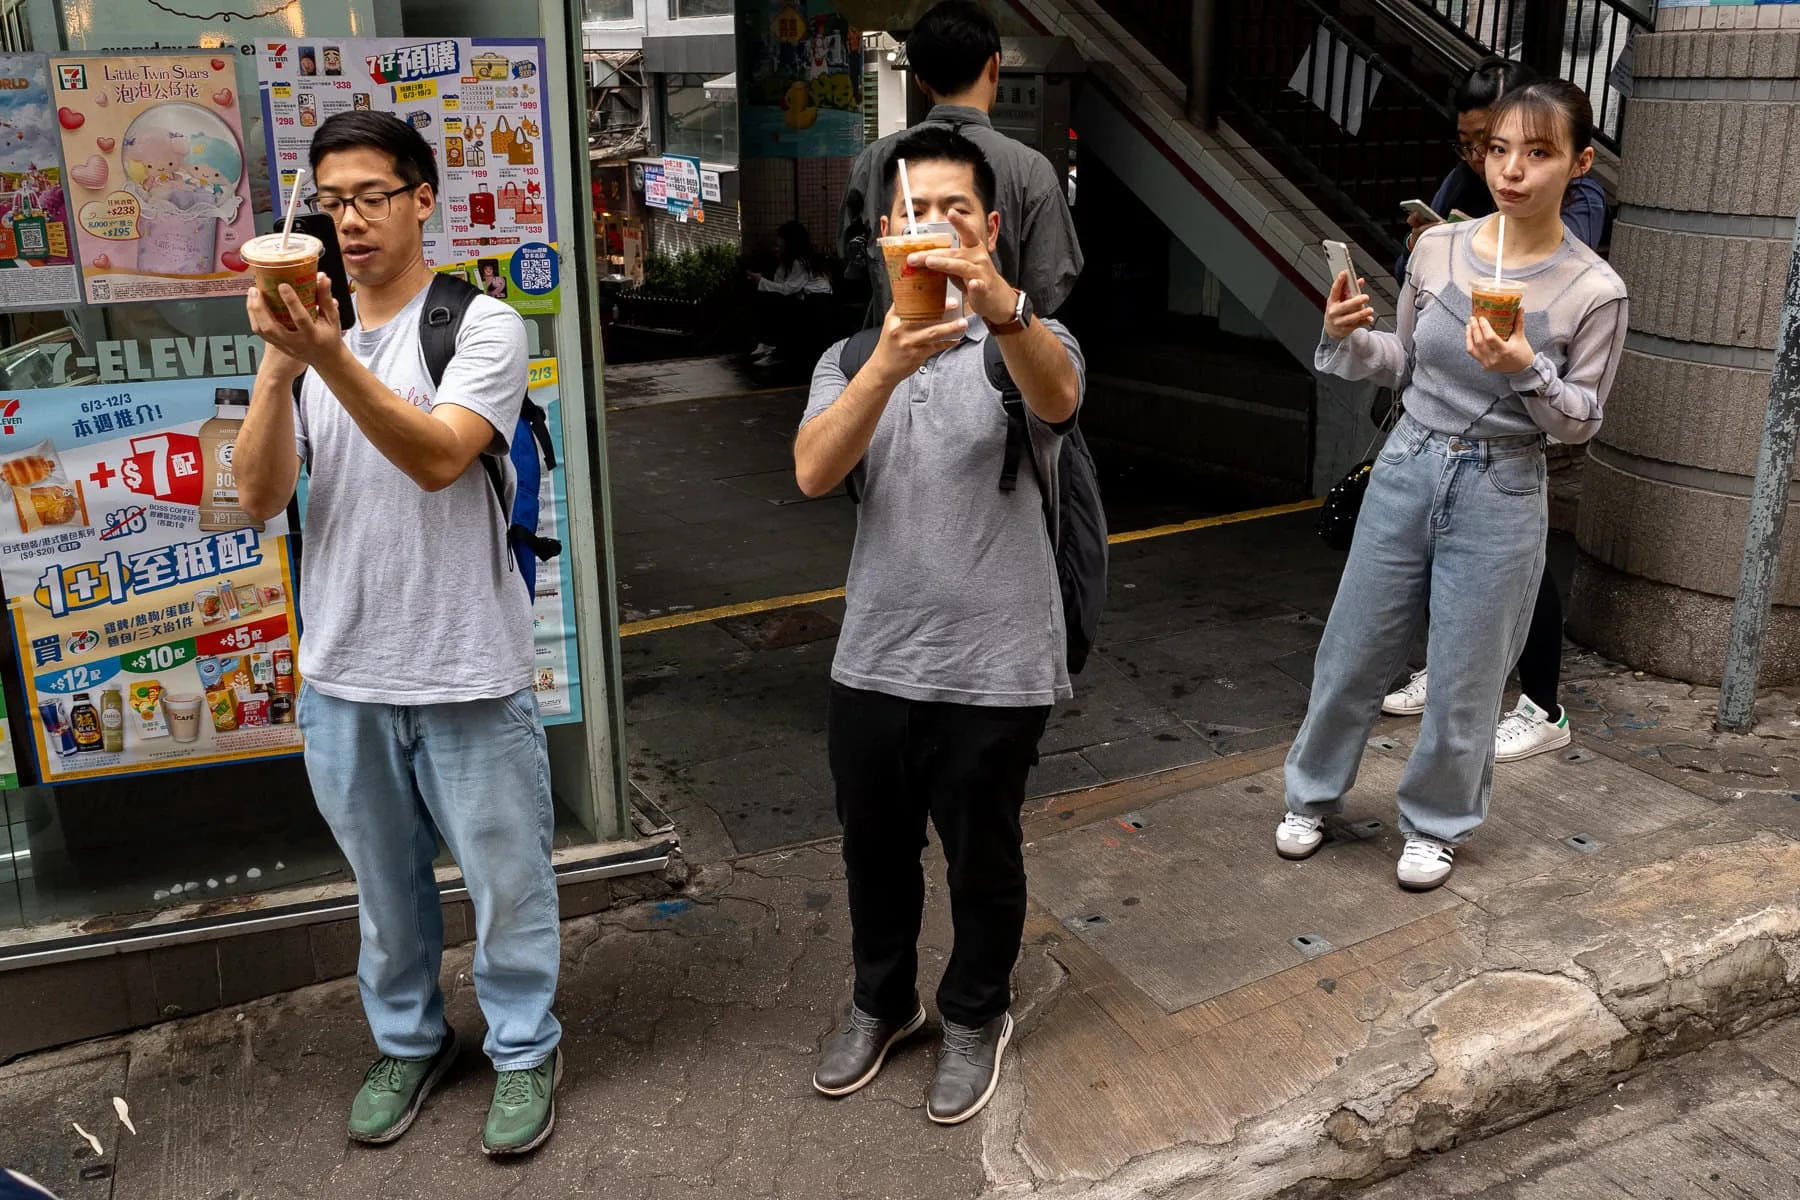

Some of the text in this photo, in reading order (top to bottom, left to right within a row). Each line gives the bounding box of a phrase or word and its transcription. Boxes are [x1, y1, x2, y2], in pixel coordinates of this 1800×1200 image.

[104, 63, 209, 81] Little Twin Stars
[116, 81, 200, 104] 泡泡公仔花
[81, 393, 132, 413] 6/3-12/3
[72, 404, 163, 438] 本週推介!
[149, 503, 197, 516] BOSS COFFEE
[32, 633, 64, 667] 買
